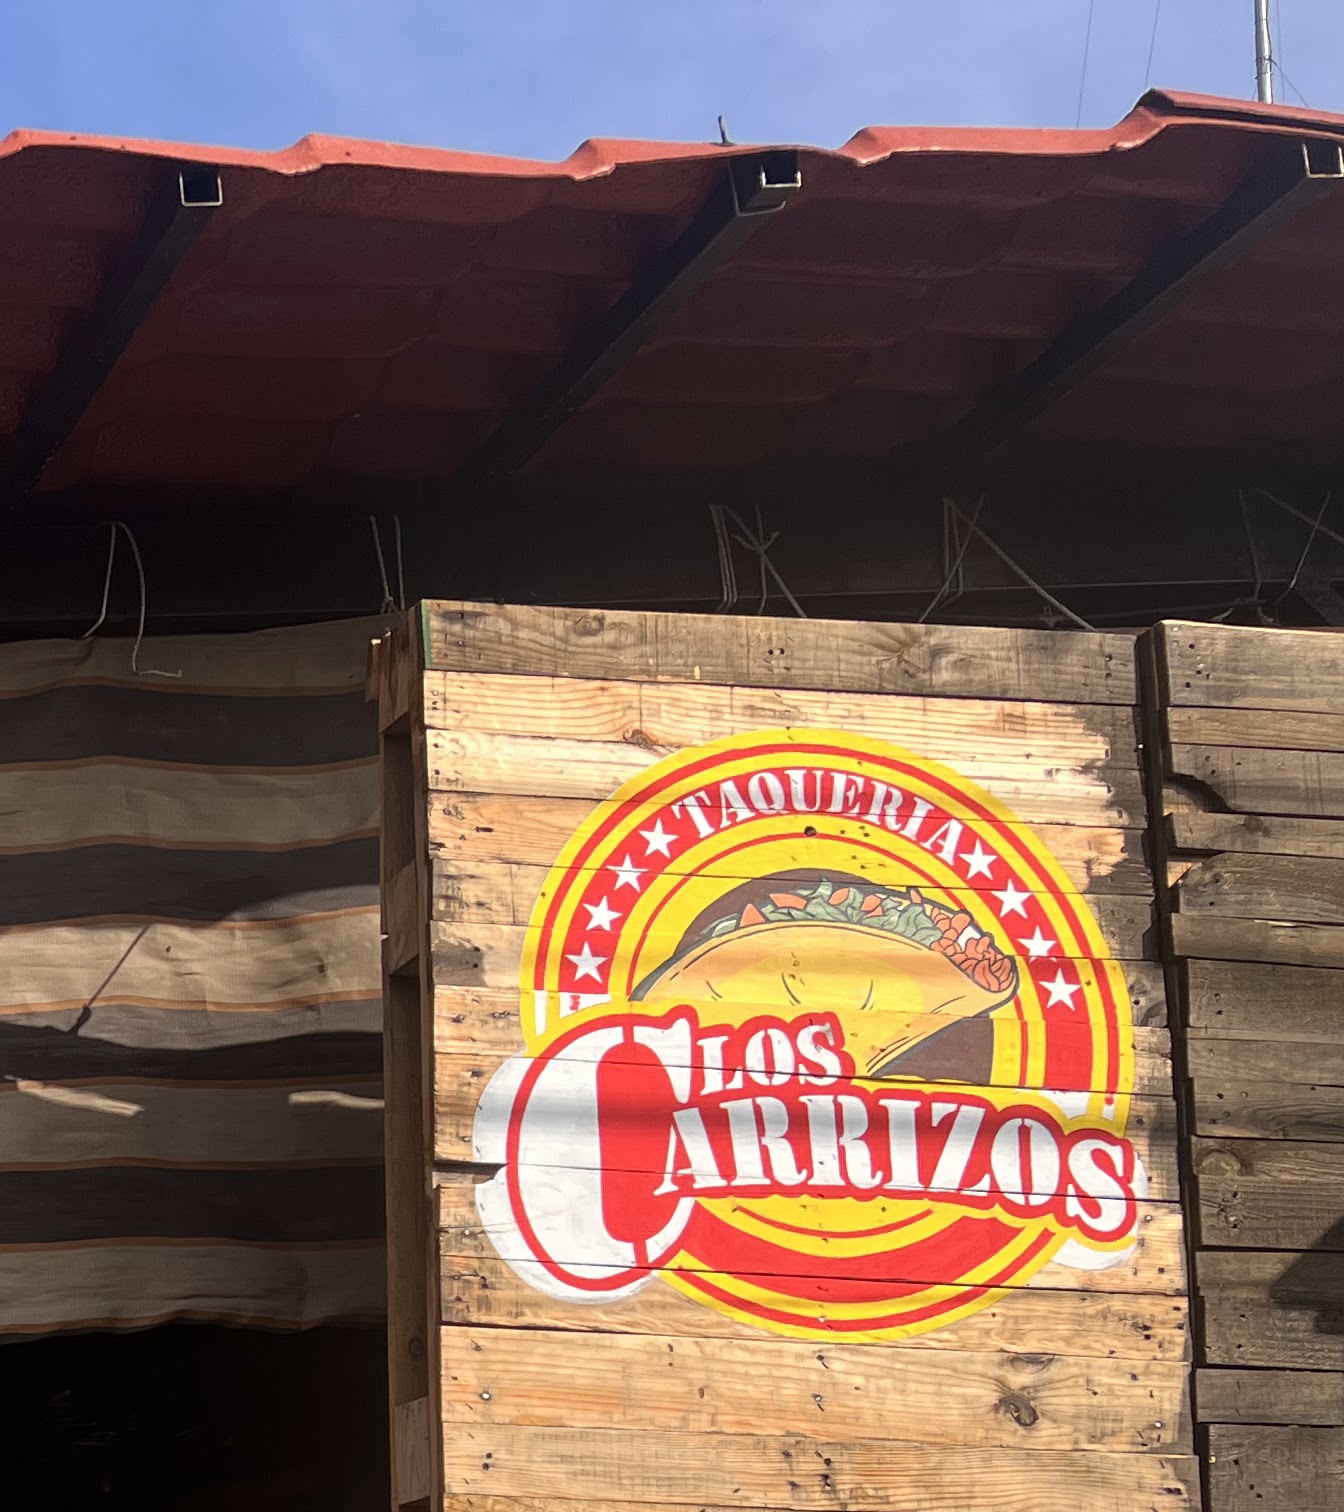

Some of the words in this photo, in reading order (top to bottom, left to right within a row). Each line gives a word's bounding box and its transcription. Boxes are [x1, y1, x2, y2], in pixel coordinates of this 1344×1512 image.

[671, 768, 964, 865] TAQUERIA
[696, 1022, 842, 1095] LOS
[517, 1017, 1127, 1281] CARRIZOS
